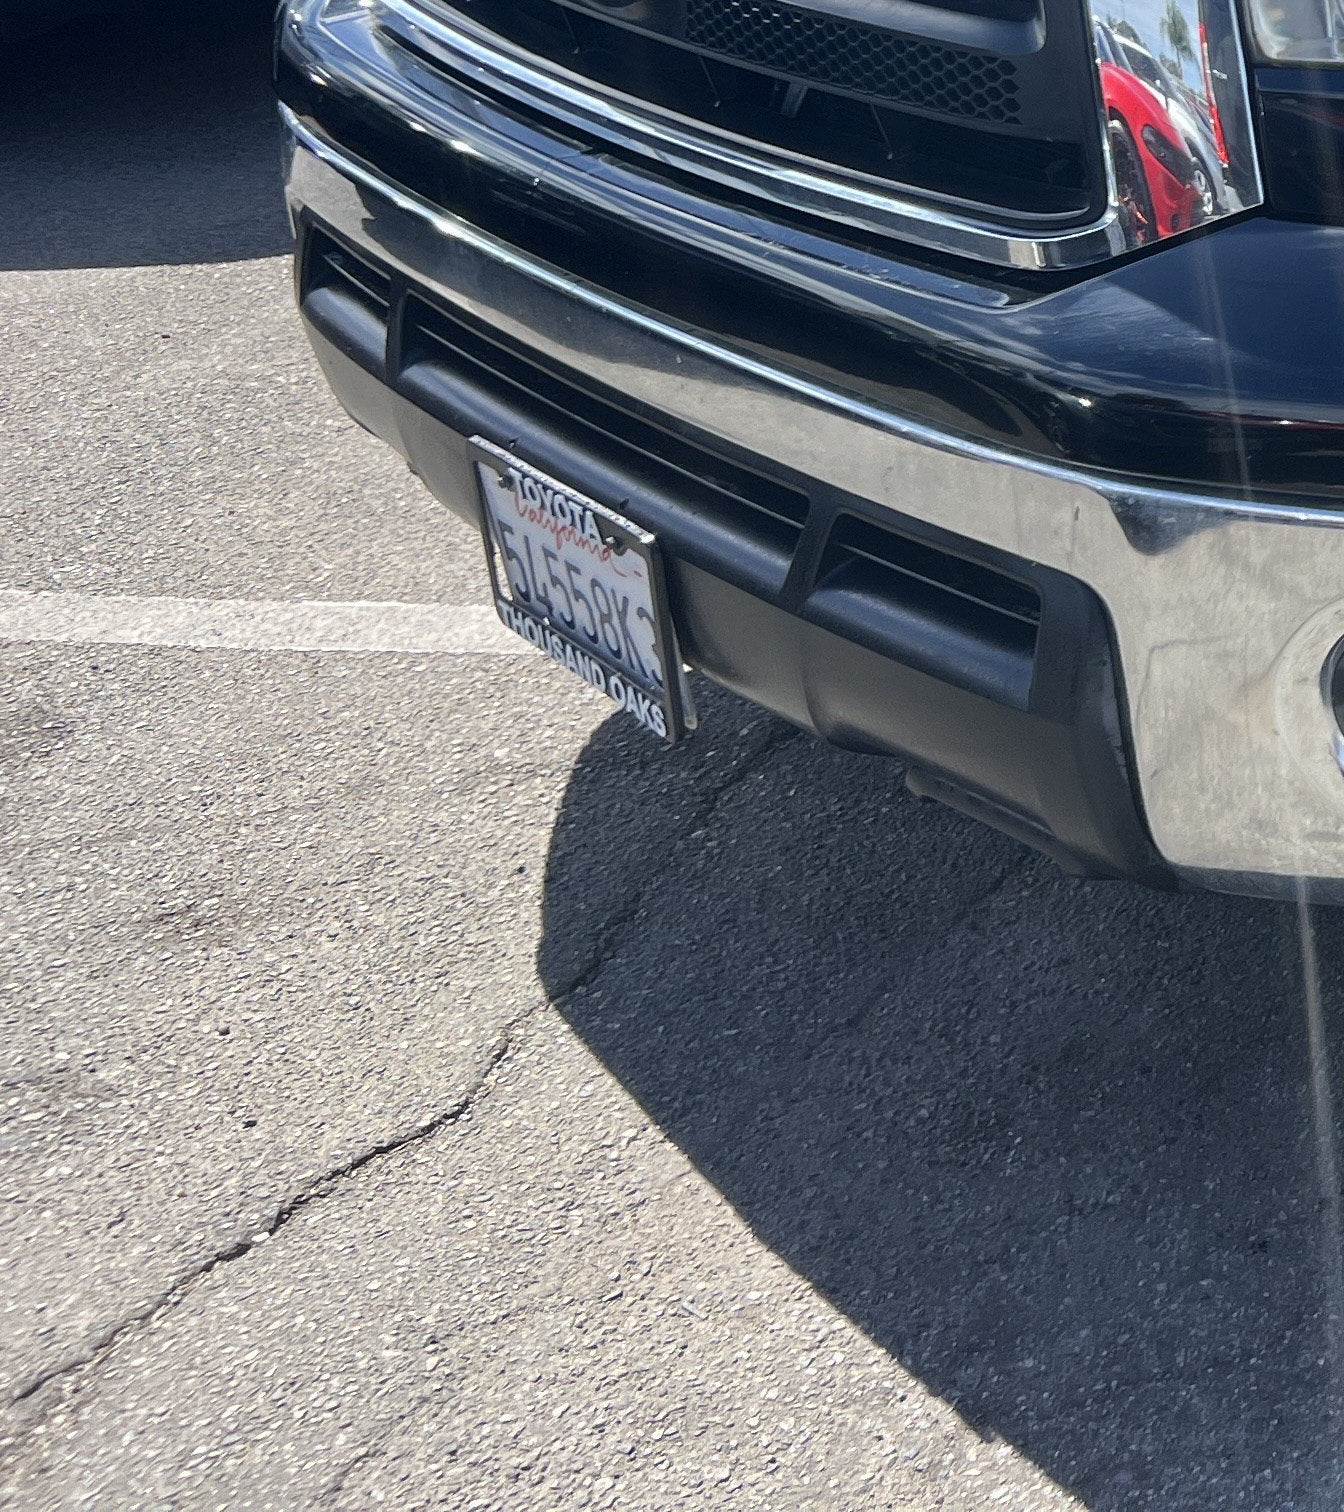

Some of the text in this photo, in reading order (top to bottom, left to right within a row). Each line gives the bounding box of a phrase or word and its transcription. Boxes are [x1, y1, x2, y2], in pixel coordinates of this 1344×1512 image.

[507, 467, 605, 543] TOYOTA
[499, 602, 668, 739] THOUSAND OAKS
